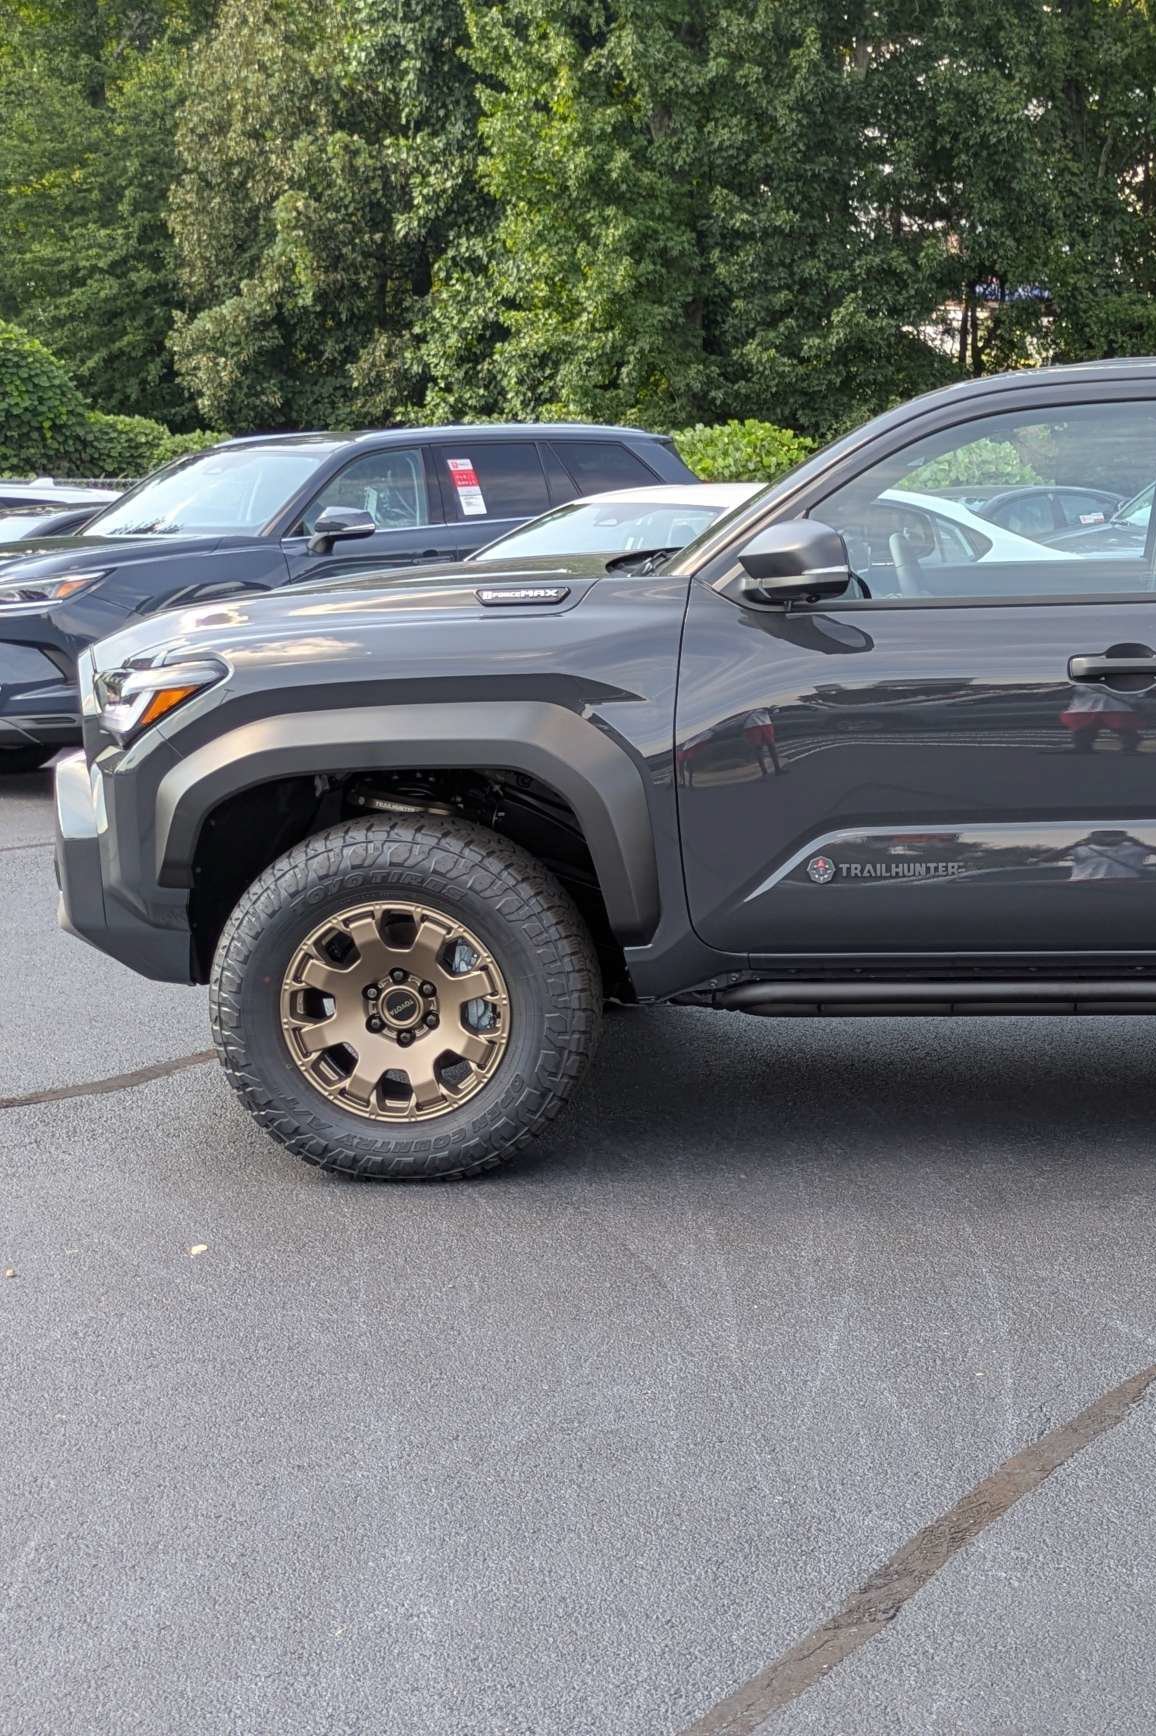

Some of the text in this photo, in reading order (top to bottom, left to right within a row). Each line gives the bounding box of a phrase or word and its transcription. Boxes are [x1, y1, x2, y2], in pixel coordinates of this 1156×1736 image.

[839, 862, 962, 878] TRAILHUNTER
[390, 999, 415, 1016] TOYOTA
[334, 1126, 468, 1154] COUNTRY
